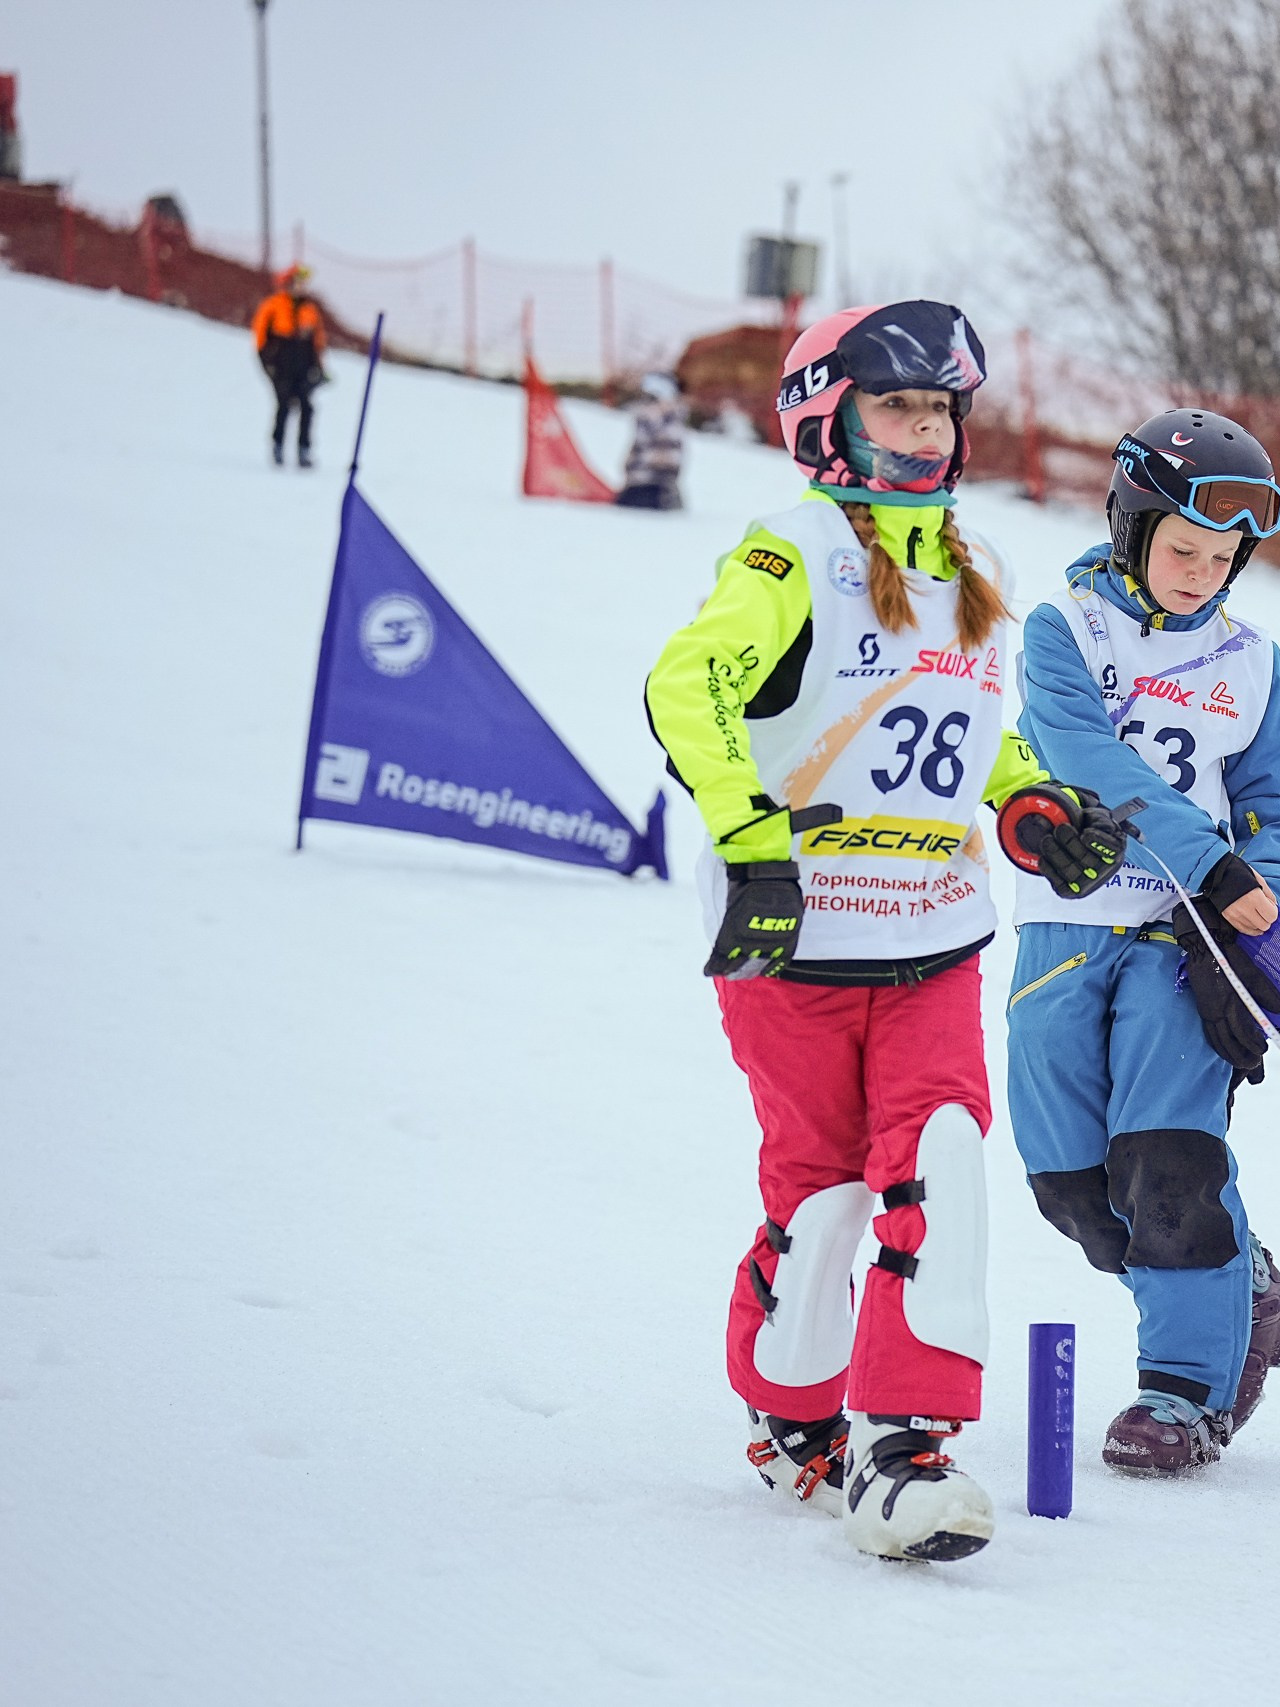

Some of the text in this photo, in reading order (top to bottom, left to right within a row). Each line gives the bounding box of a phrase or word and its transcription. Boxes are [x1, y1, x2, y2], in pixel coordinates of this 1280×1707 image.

[745, 551, 788, 576] SHS
[835, 668, 900, 678] SCOTT
[1202, 702, 1240, 720] Löffler
[871, 706, 970, 798] 38
[375, 762, 631, 863] Rosengineering
[748, 916, 797, 931] LEKI
